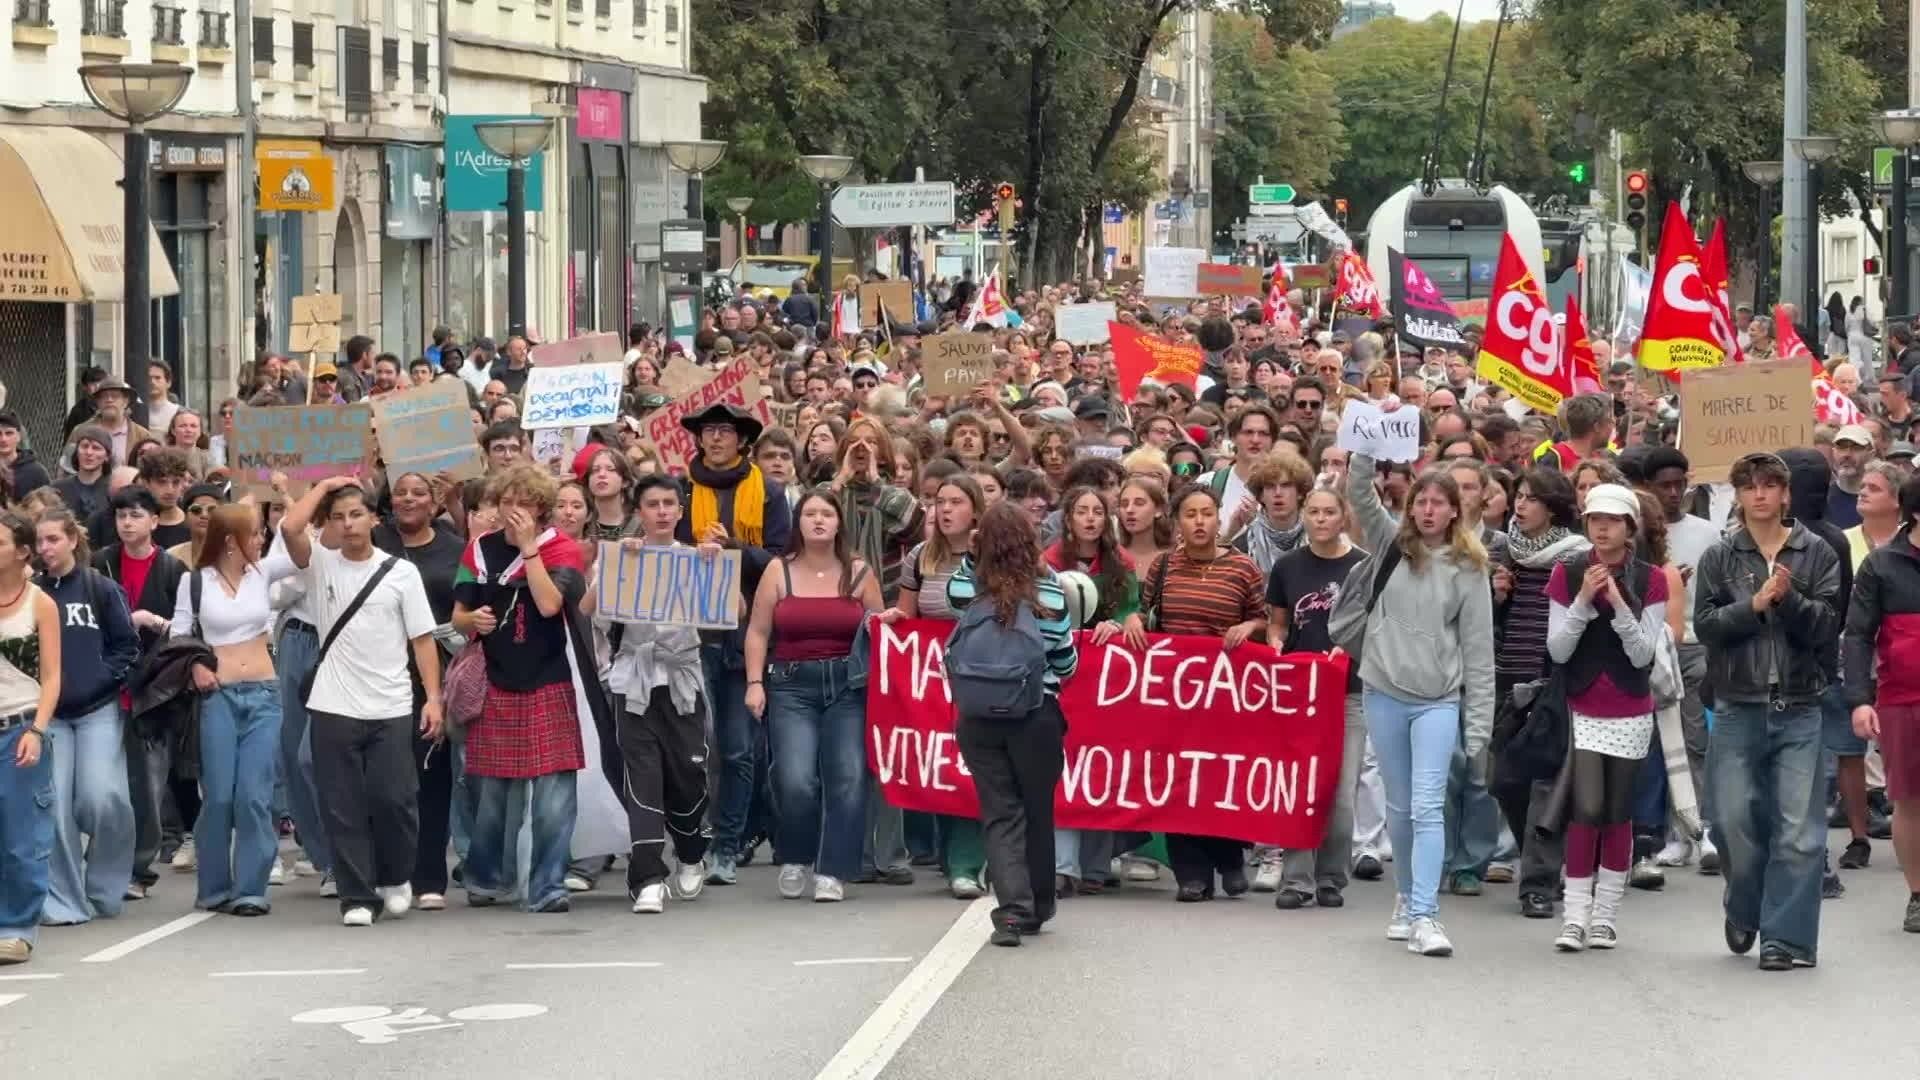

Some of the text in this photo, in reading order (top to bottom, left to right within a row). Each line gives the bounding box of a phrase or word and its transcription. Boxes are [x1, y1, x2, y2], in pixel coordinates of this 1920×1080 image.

[455, 150, 531, 176] l'Adrese
[1766, 394, 1789, 411] DE
[880, 623, 952, 703] MA
[873, 724, 958, 791] VIVE
